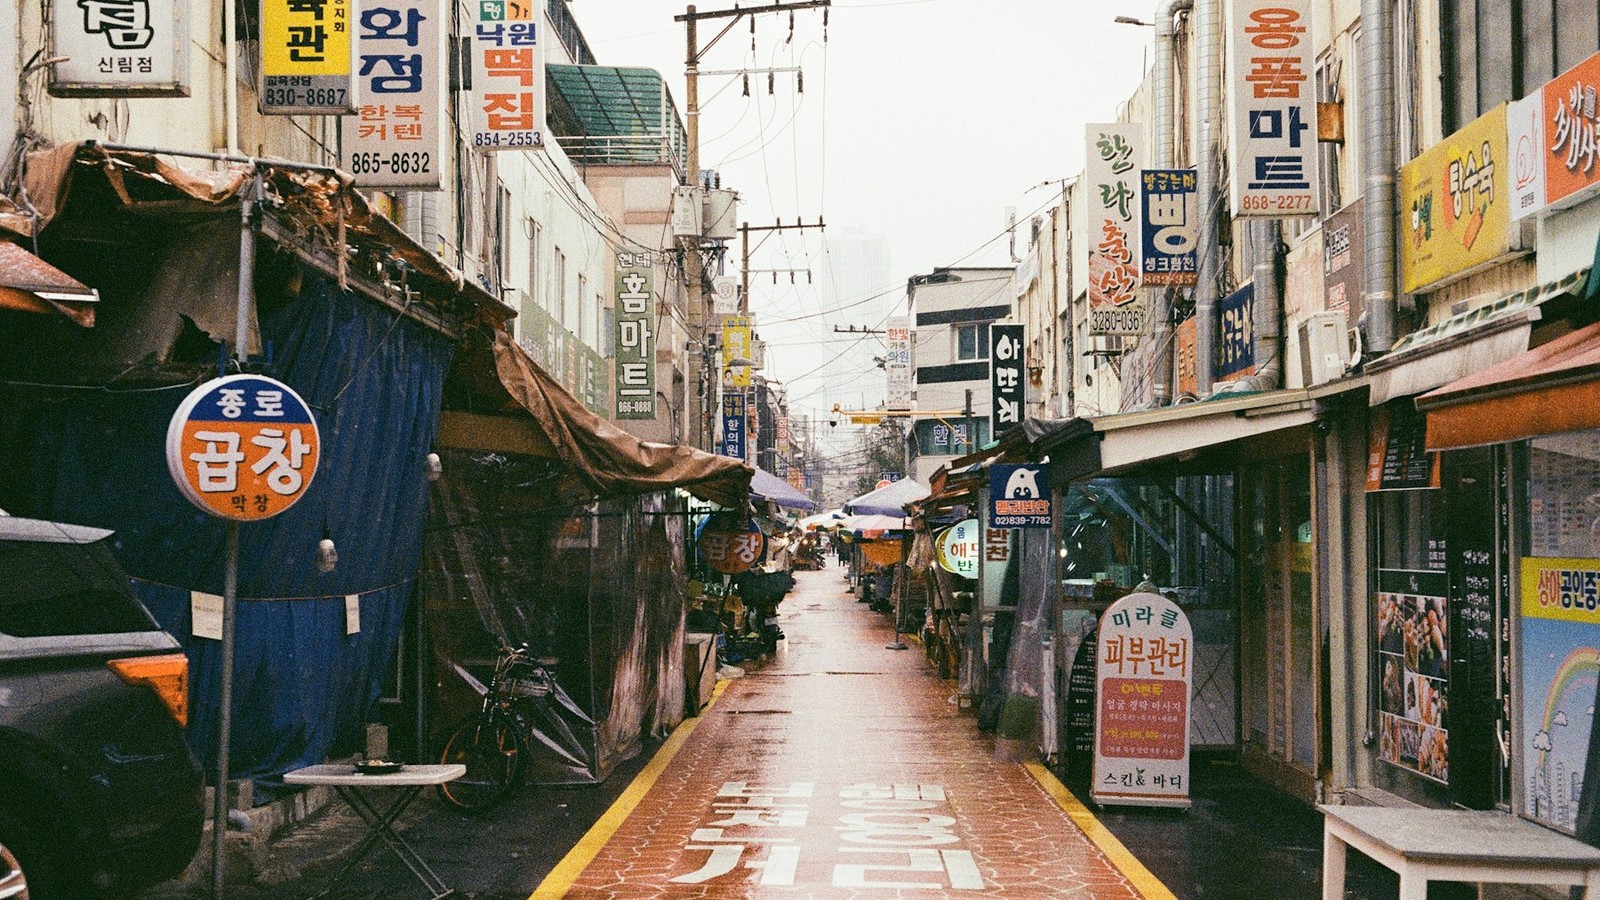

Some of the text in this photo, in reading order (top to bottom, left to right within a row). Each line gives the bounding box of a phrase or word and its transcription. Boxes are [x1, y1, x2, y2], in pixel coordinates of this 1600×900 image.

[476, 23, 536, 46] 낙원
[98, 57, 152, 73] 신림점
[266, 89, 346, 105] 830-8687
[482, 49, 534, 130] 떡집
[359, 105, 423, 121] 한복
[358, 124, 422, 140] 커텐
[475, 132, 541, 146] 854-2553
[352, 153, 430, 174] 865-8632
[1449, 140, 1495, 220] 탕수육
[1243, 195, 1312, 210] 868-2277
[1096, 133, 1135, 306] 한라축산
[1149, 192, 1198, 254] 빵
[619, 273, 652, 397] 홈마트
[217, 389, 284, 418] 종로
[727, 419, 740, 457] 한의원
[189, 428, 311, 495] 곱창
[232, 494, 268, 512] 막창
[995, 516, 1050, 525] 02)839-7782
[986, 529, 1010, 561] 반찬
[1112, 606, 1178, 629] 미라클
[1104, 634, 1187, 677] 피부관리
[1152, 700, 1181, 712] 마사지
[1153, 774, 1181, 790] 바디
